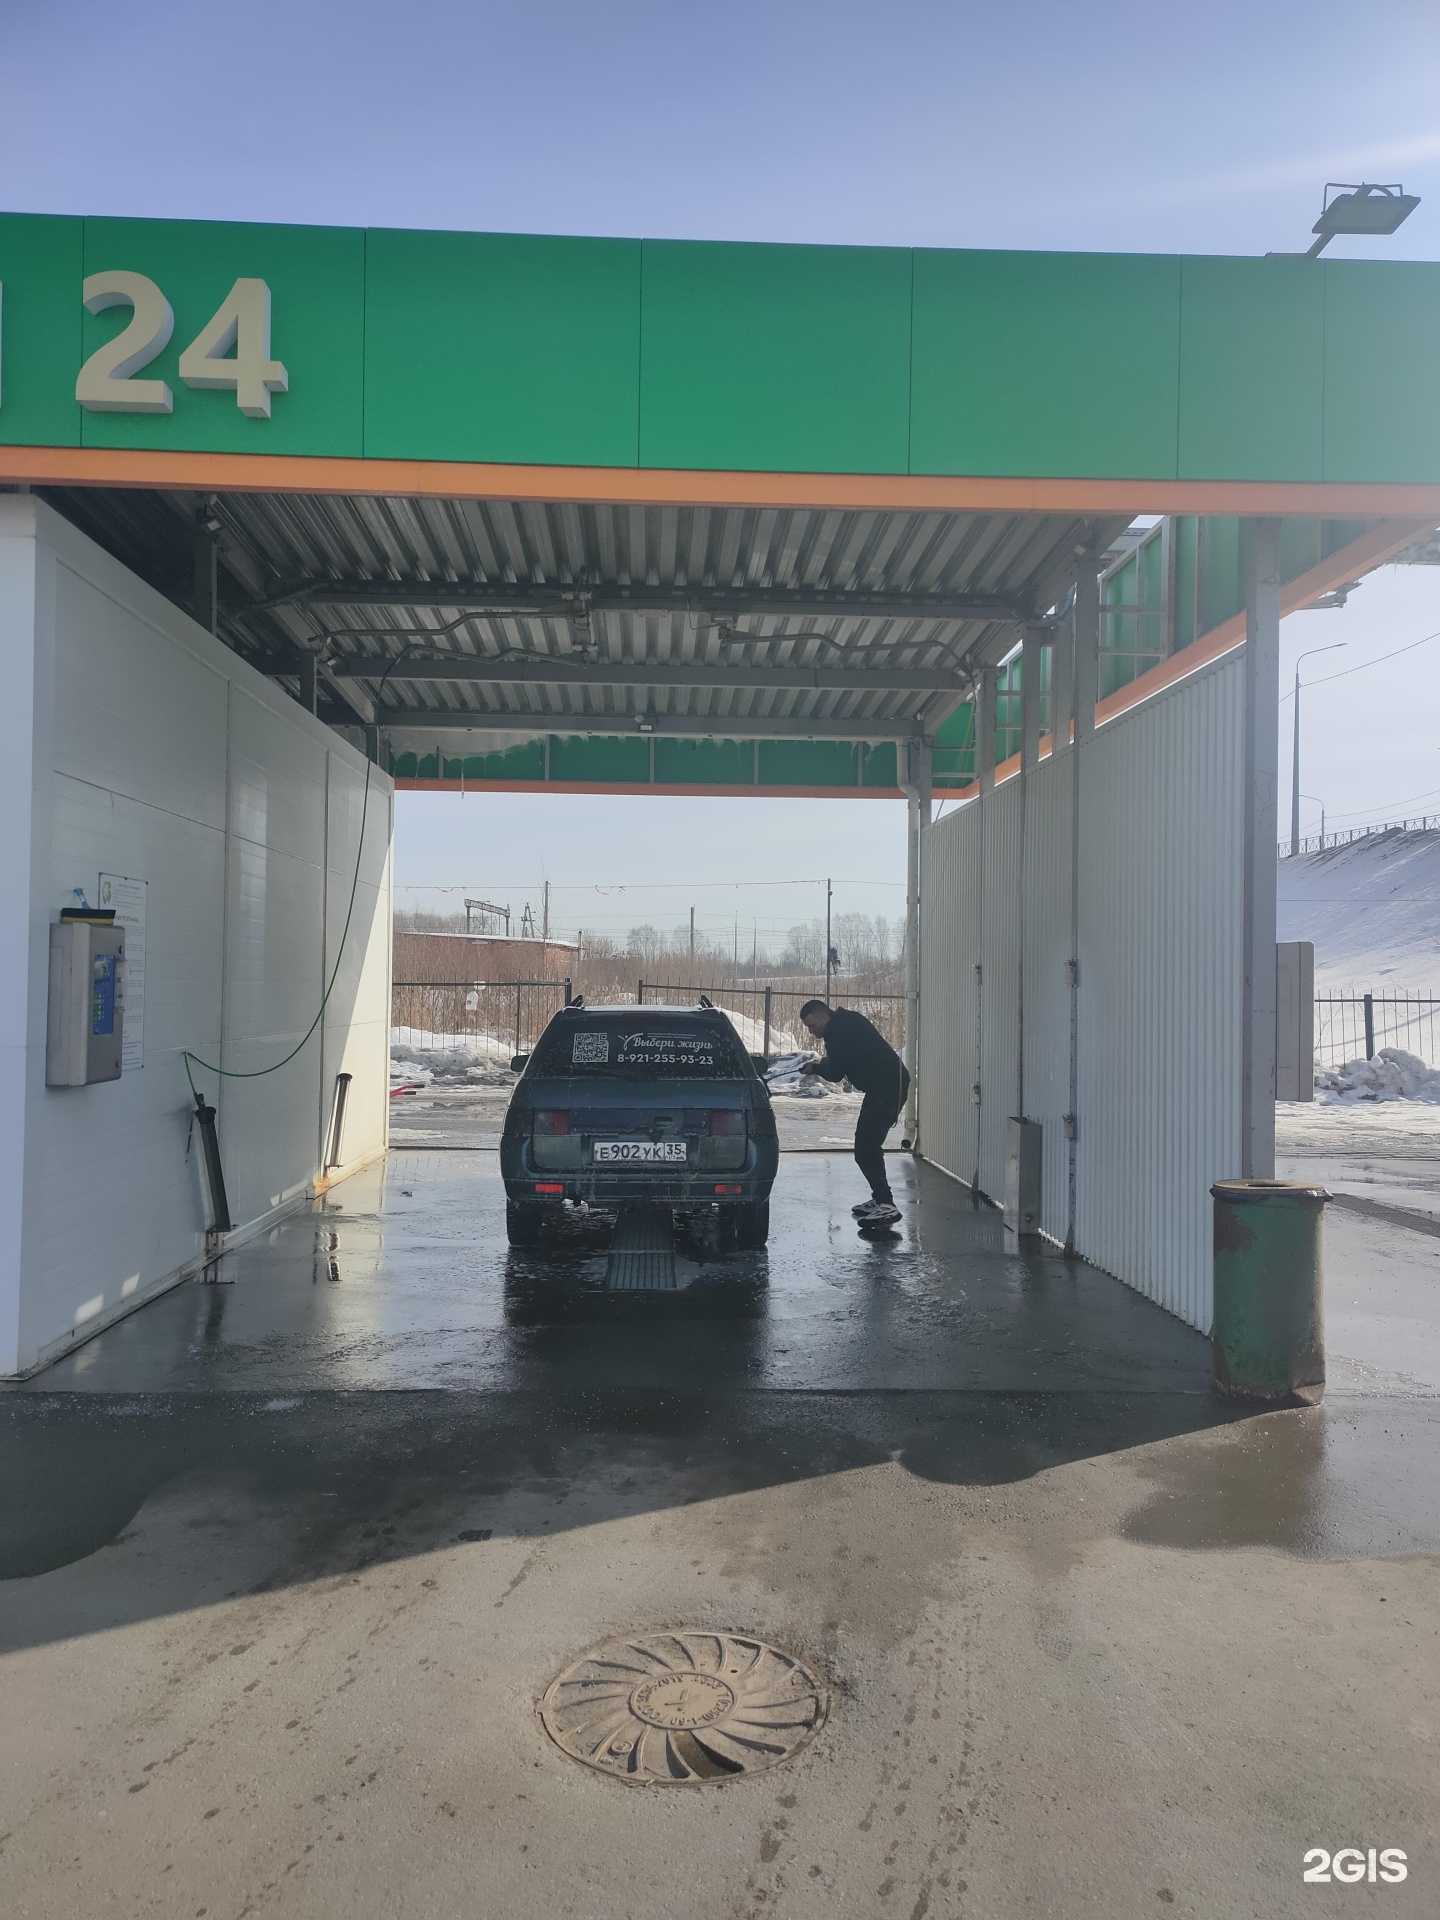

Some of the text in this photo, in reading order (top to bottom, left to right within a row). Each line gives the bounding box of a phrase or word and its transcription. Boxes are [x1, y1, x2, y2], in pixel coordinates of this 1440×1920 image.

[76, 270, 288, 418] 24
[634, 1037, 713, 1053] Выбери жизнь
[617, 1054, 713, 1065] 8-921-255-93-23
